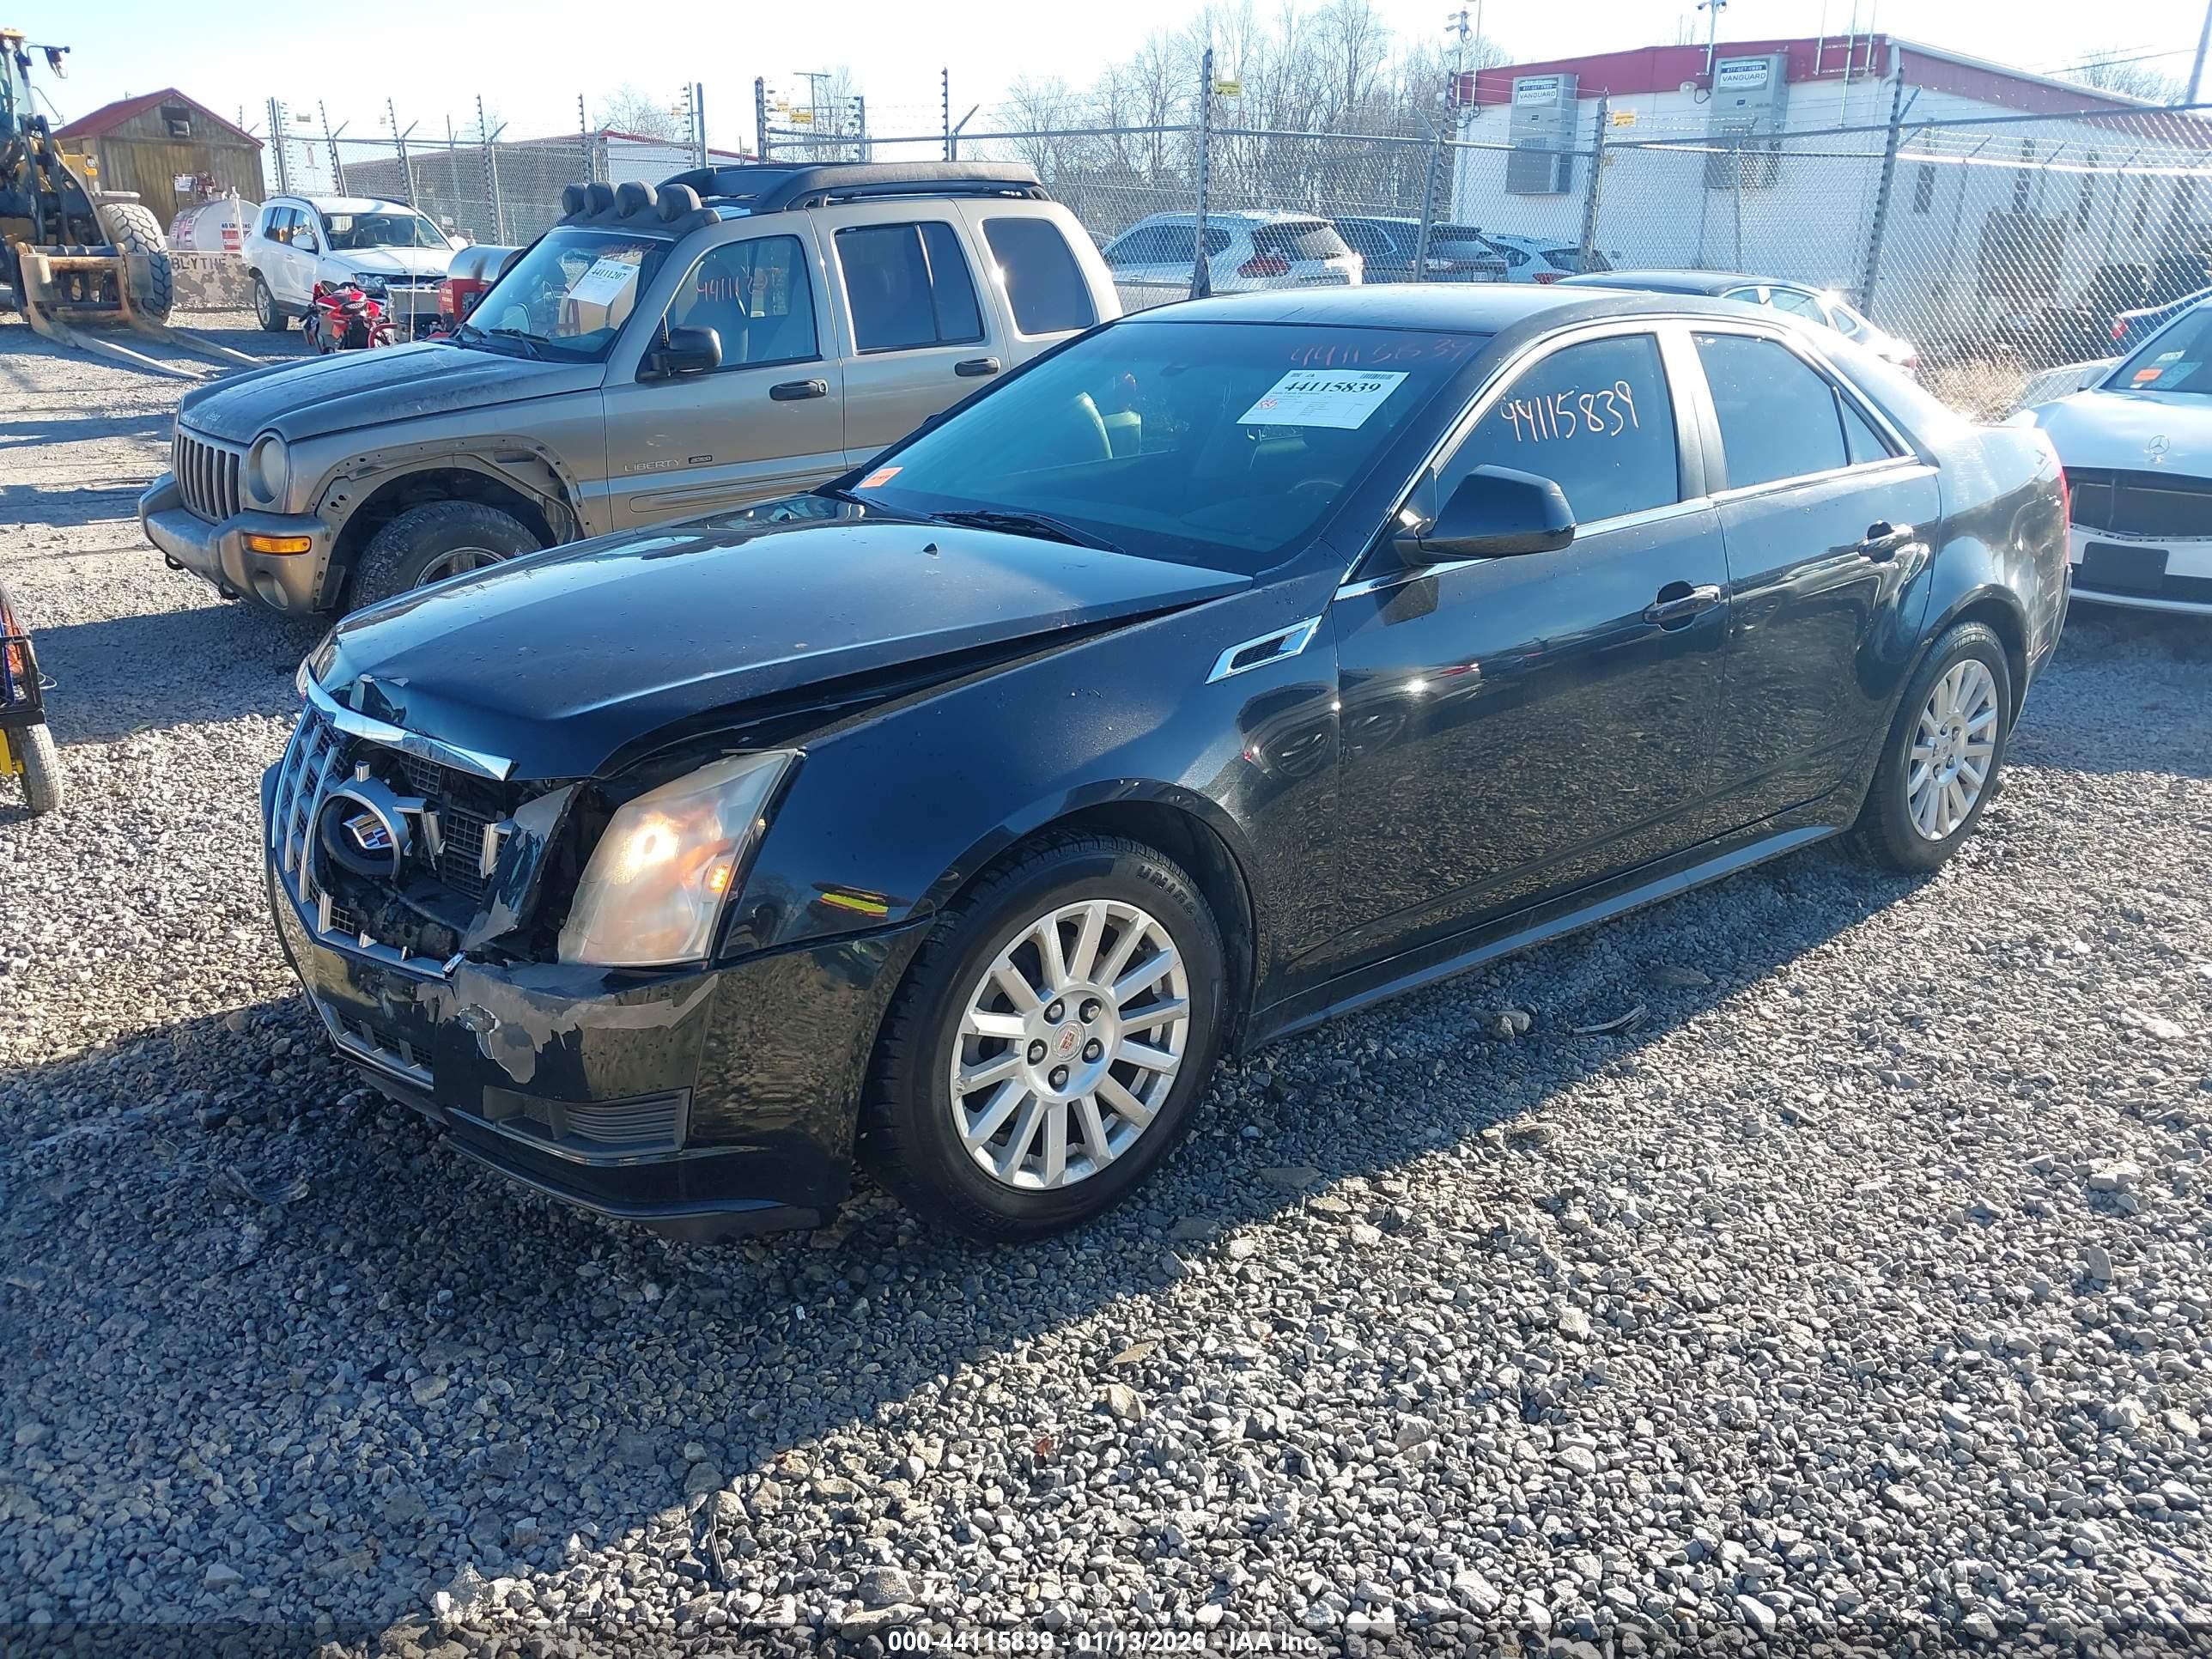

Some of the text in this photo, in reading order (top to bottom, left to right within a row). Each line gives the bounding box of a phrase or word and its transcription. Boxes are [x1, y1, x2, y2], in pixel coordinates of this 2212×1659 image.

[1723, 73, 1766, 82] VANGUARD
[1519, 91, 1556, 100] VANGUARD
[591, 267, 628, 280] 44111207
[1284, 380, 1382, 394] 44115839
[1500, 380, 1639, 442] 44115839
[624, 459, 681, 471] LIBERTY
